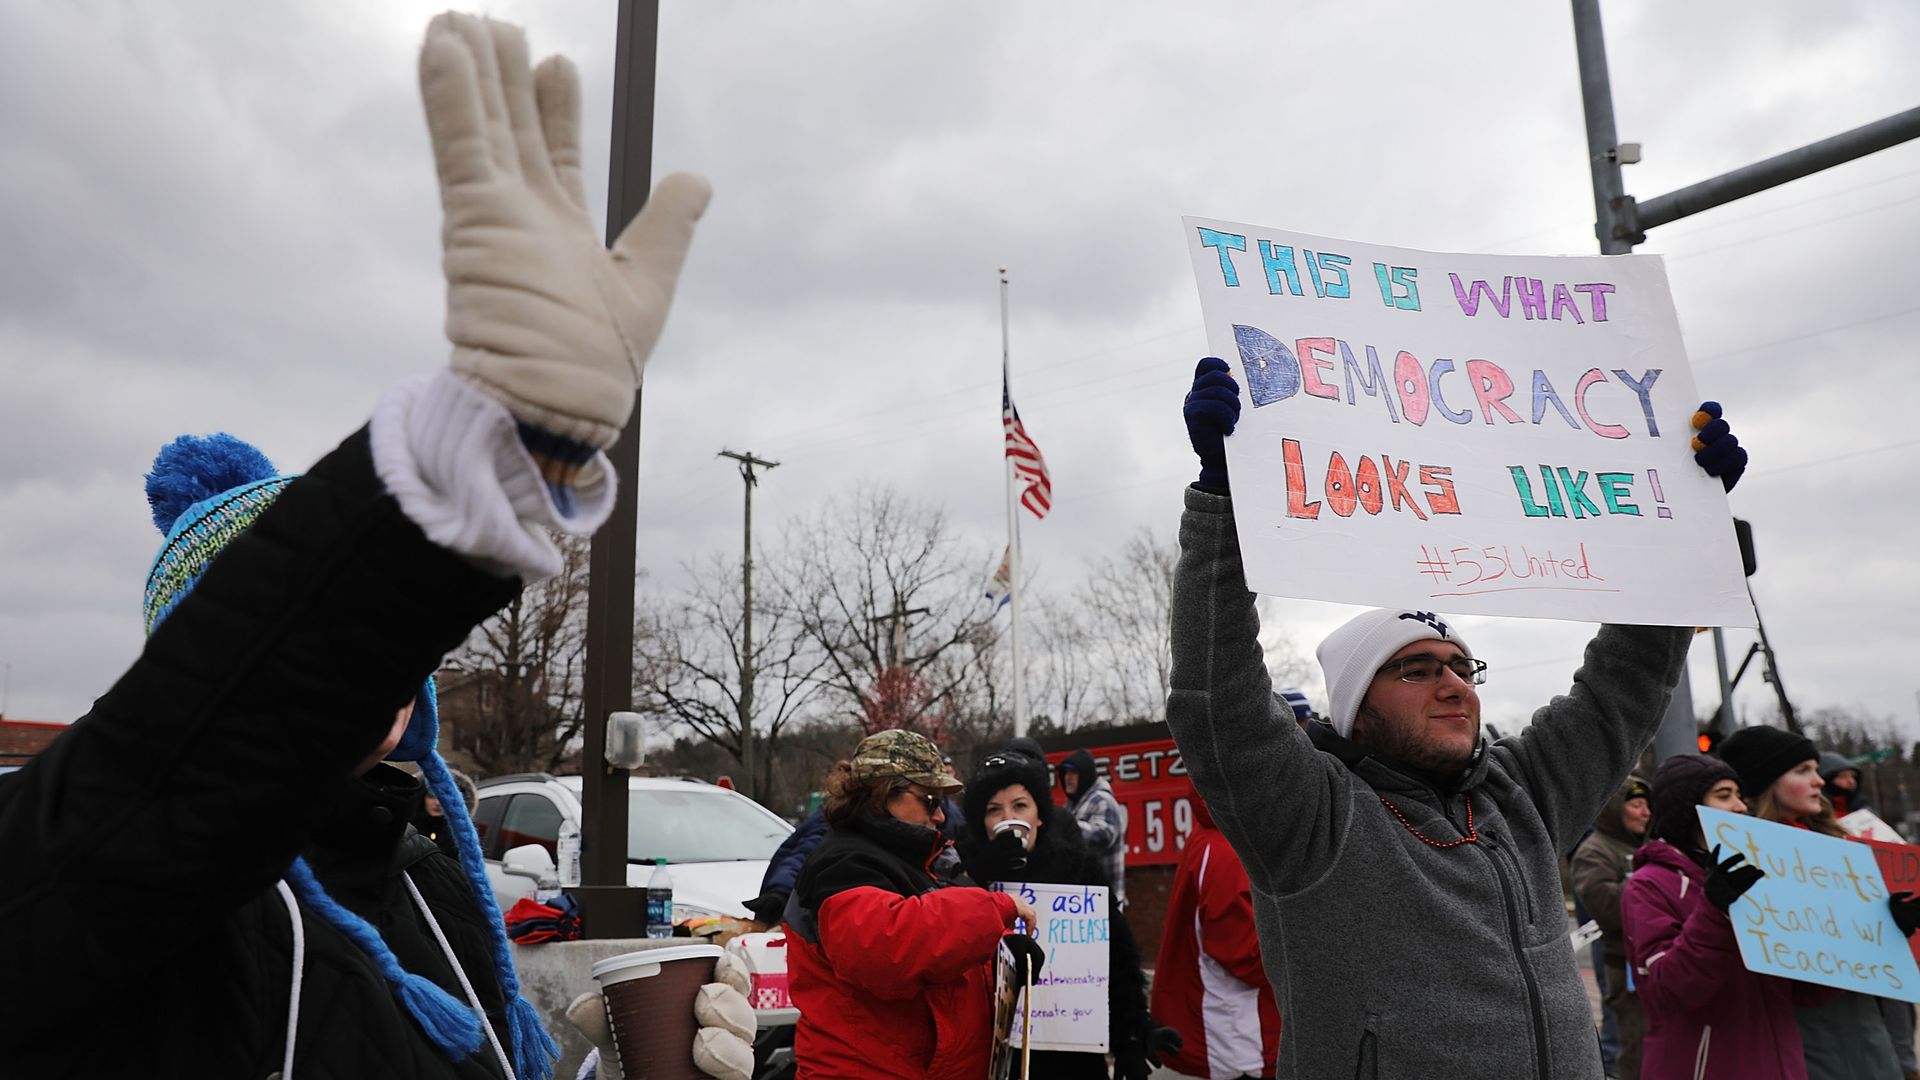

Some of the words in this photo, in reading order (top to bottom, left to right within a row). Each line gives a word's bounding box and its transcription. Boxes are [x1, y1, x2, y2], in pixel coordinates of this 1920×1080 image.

[1198, 227, 1351, 299] THIS
[1373, 262, 1421, 312] IS
[1449, 272, 1615, 324] WHAT
[1232, 324, 1662, 439] DEMOCRACY
[1281, 438, 1462, 521] LOOKS
[1507, 464, 1673, 520] LIKE!
[1417, 543, 1603, 584] #55United
[1716, 822, 1883, 903] Students
[1048, 918, 1109, 943] RELEASE
[1052, 885, 1097, 915] ask
[1741, 892, 1843, 939] Stand
[1747, 928, 1903, 989] Teachers
